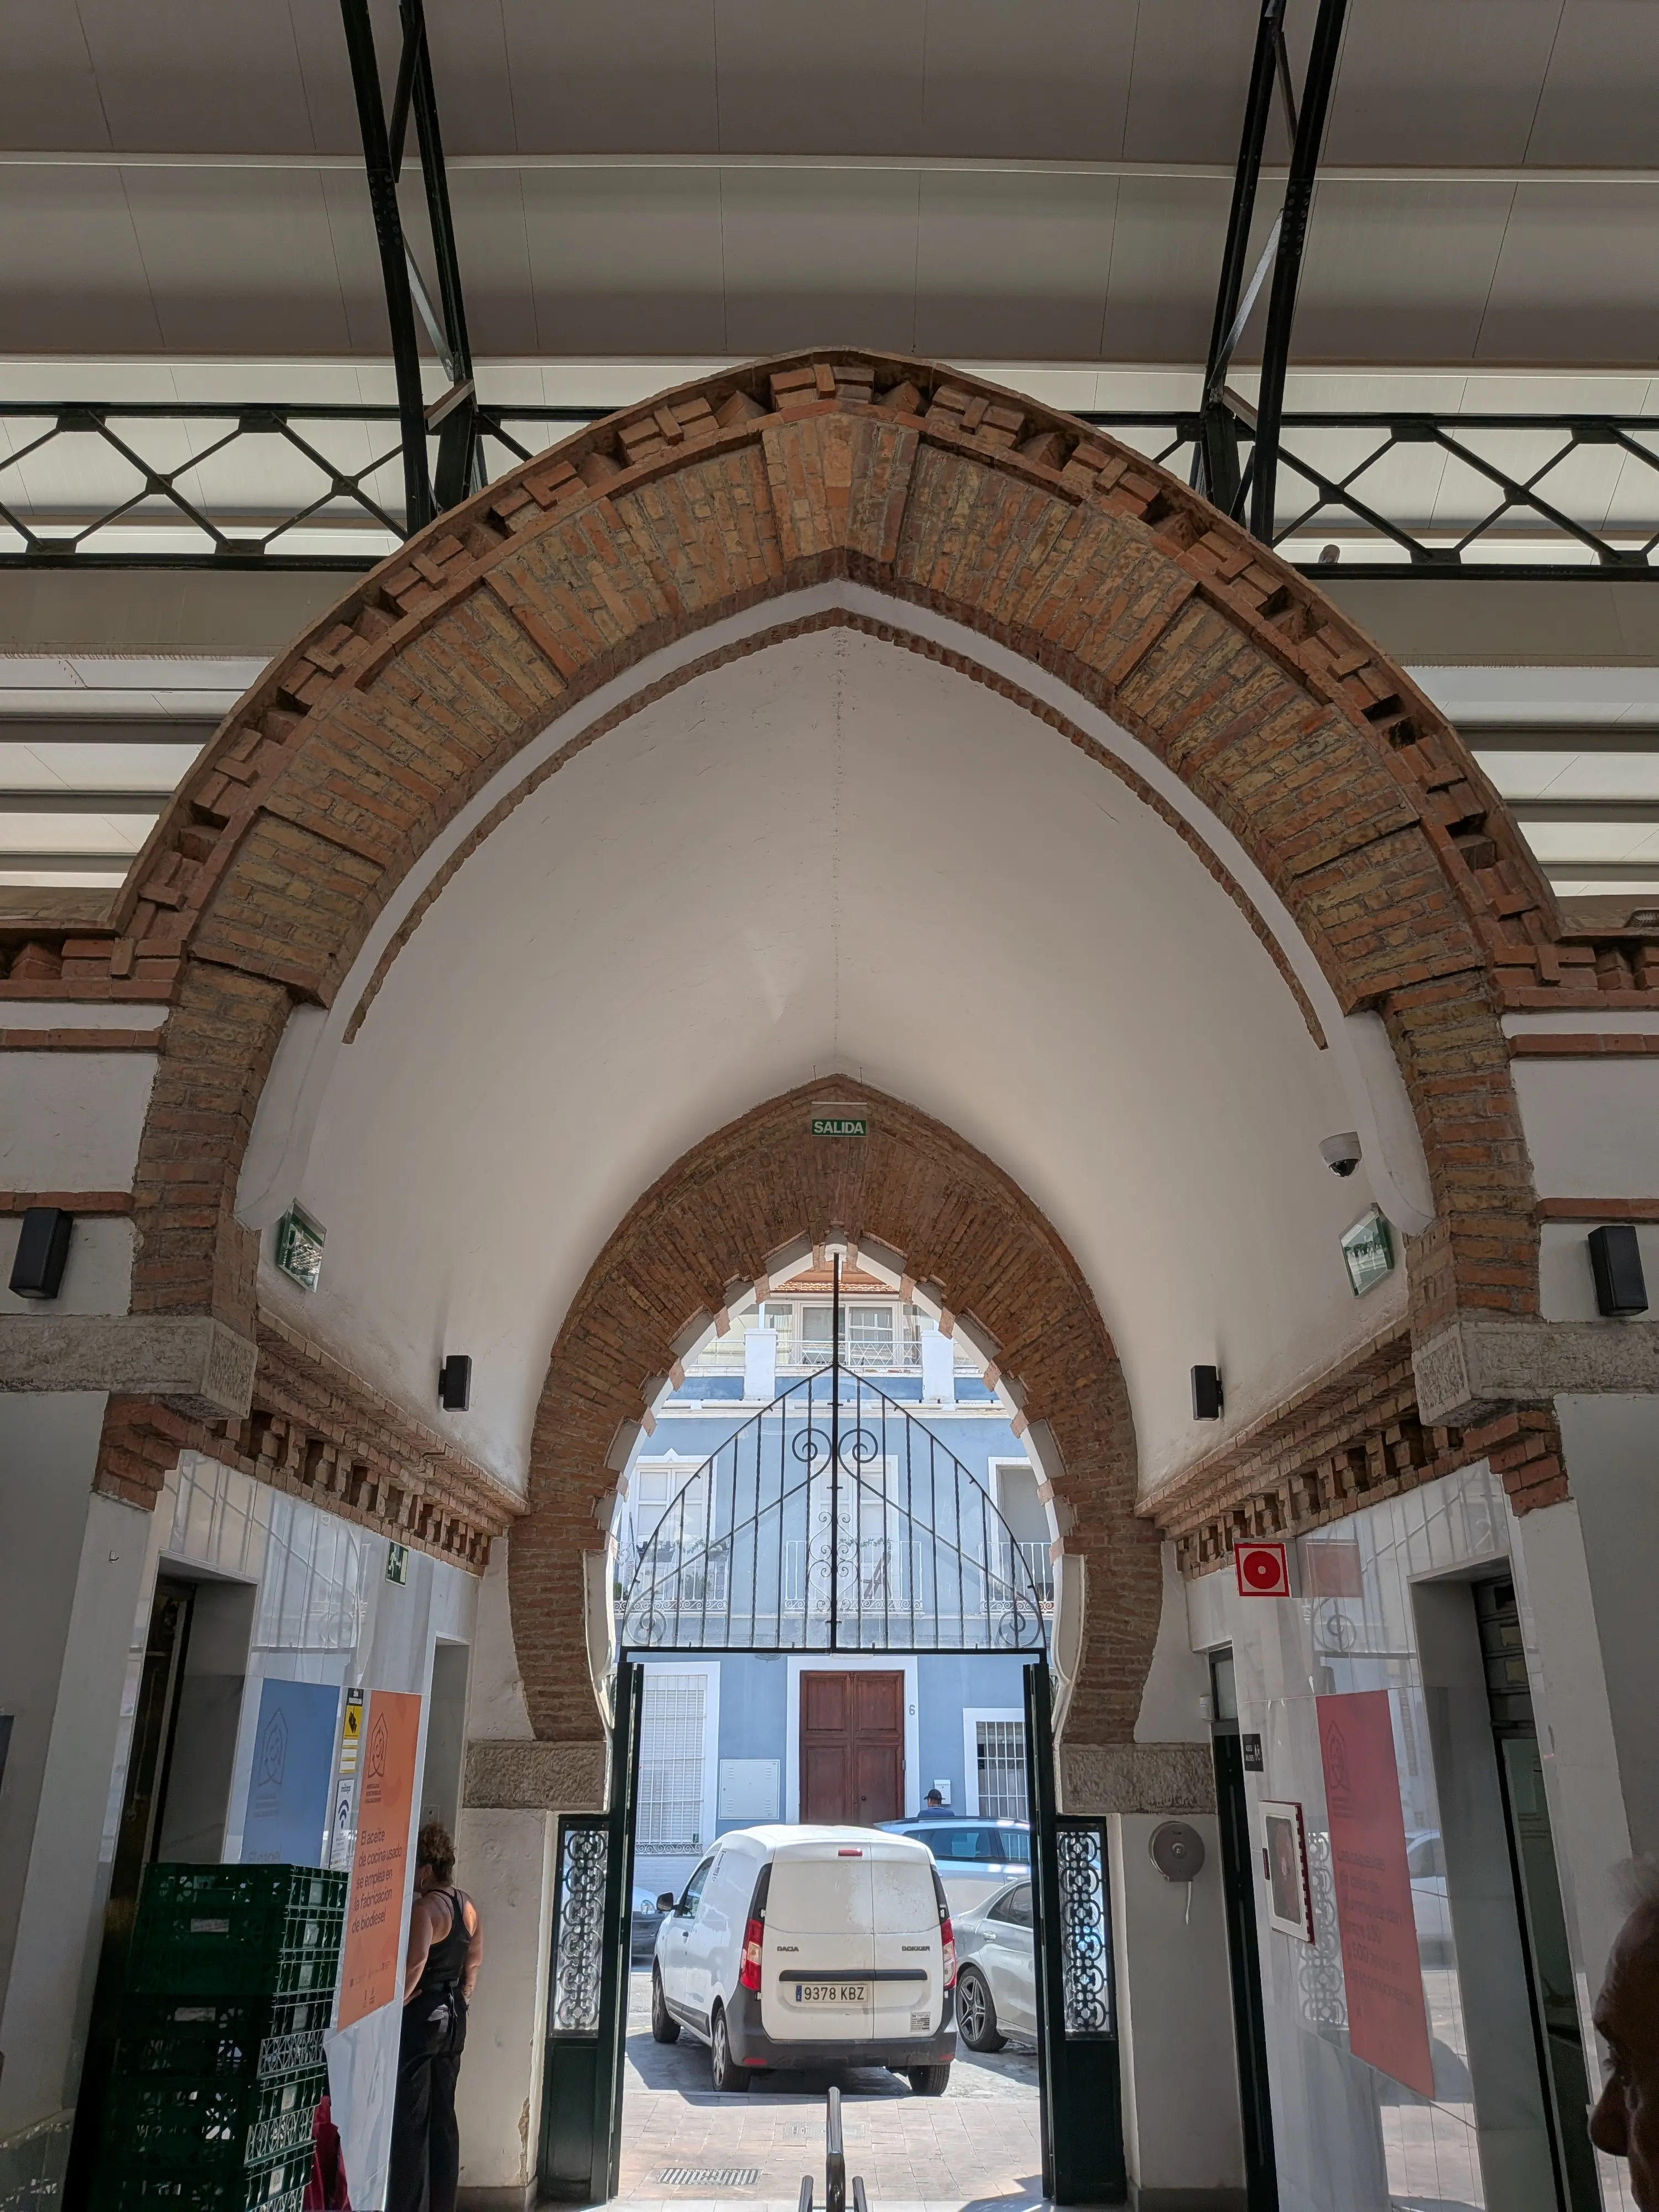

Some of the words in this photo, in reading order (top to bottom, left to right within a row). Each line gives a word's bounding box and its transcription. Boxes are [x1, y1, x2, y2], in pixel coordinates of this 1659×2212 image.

[813, 1121, 864, 1134] SALIDA
[909, 1704, 915, 1715] 6
[361, 1830, 367, 1846] El
[367, 1828, 385, 1845] aceite
[359, 1851, 367, 1867] de
[367, 1848, 386, 1866] cocina
[387, 1843, 403, 1861] usado
[356, 1876, 364, 1890] se
[364, 1870, 385, 1888] emplea
[385, 1869, 393, 1880] en
[354, 1896, 359, 1911] la
[352, 1916, 361, 1934] de
[361, 1907, 386, 1930] biodiesel
[804, 1987, 836, 2000] 9378
[841, 1987, 864, 2000] KBZ
